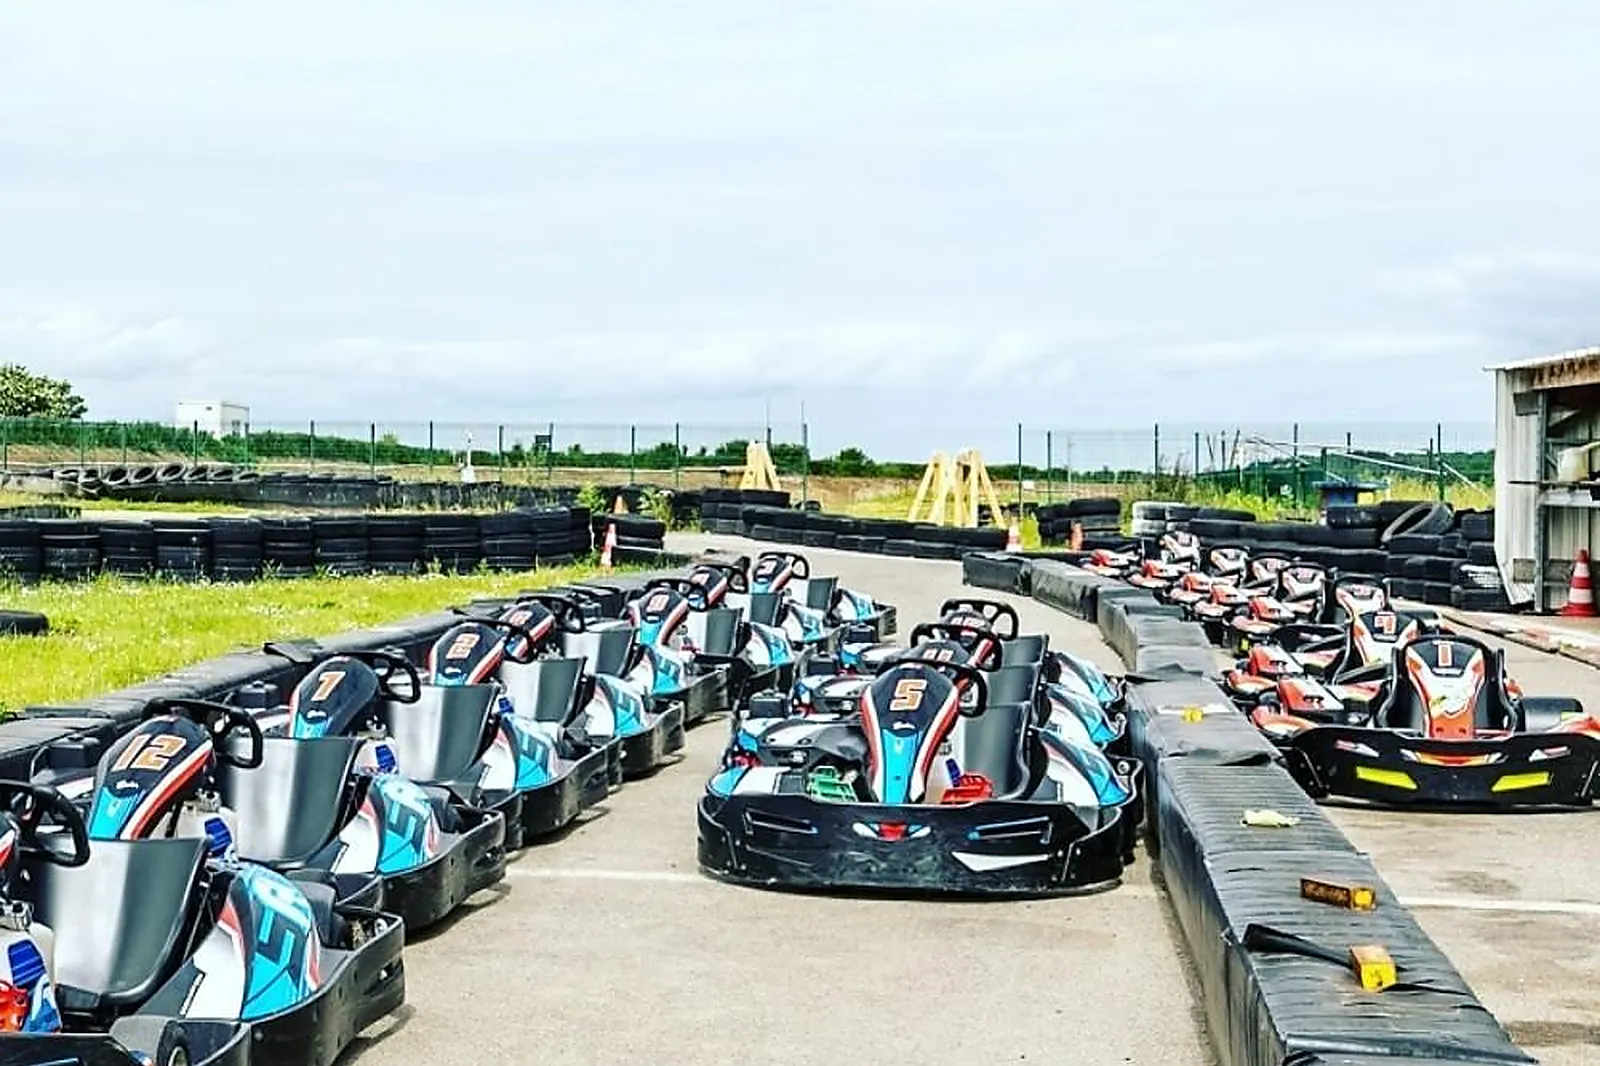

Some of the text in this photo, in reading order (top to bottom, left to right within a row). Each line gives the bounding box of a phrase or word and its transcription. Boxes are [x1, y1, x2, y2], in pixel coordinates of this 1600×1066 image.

[1438, 644, 1452, 666] 1
[890, 679, 927, 711] 5
[113, 734, 187, 771] 12
